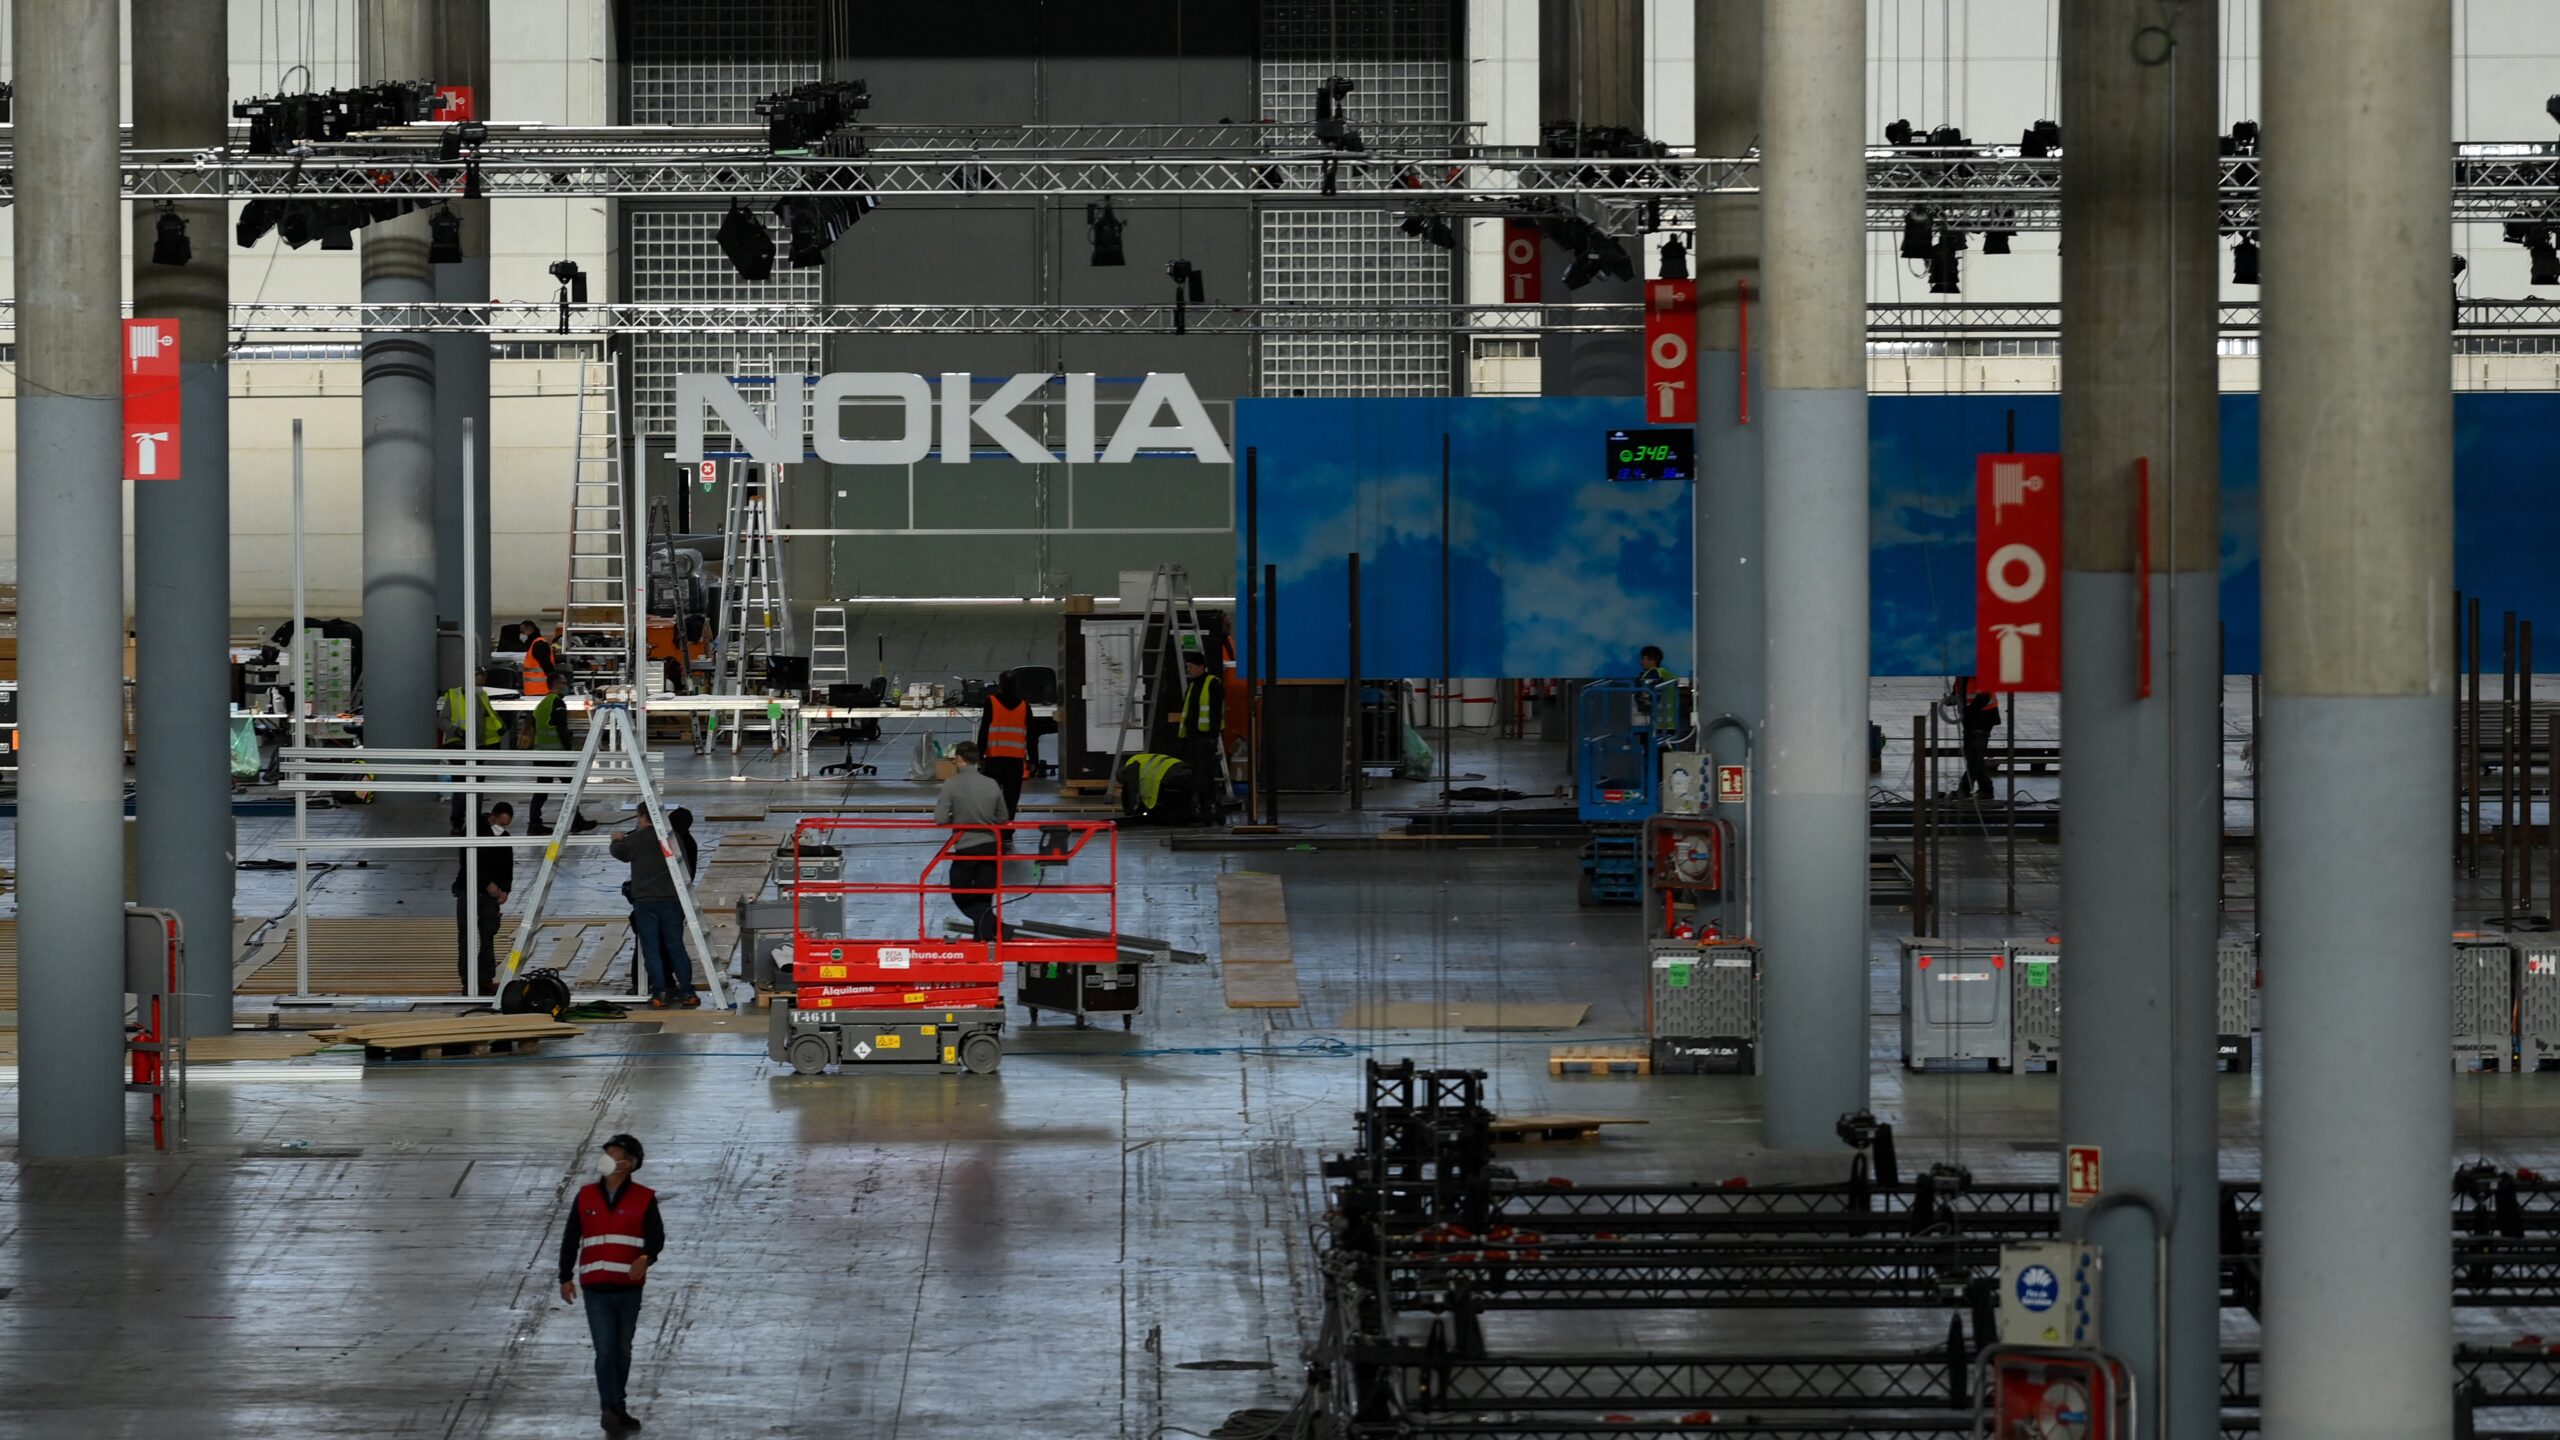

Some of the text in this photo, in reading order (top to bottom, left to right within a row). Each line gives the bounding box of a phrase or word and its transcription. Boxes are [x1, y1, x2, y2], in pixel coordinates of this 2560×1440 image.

[675, 372, 1234, 464] NOKIA
[1633, 445, 1669, 461] 348
[822, 986, 875, 996] Alquilame
[791, 1011, 836, 1022] T4611
